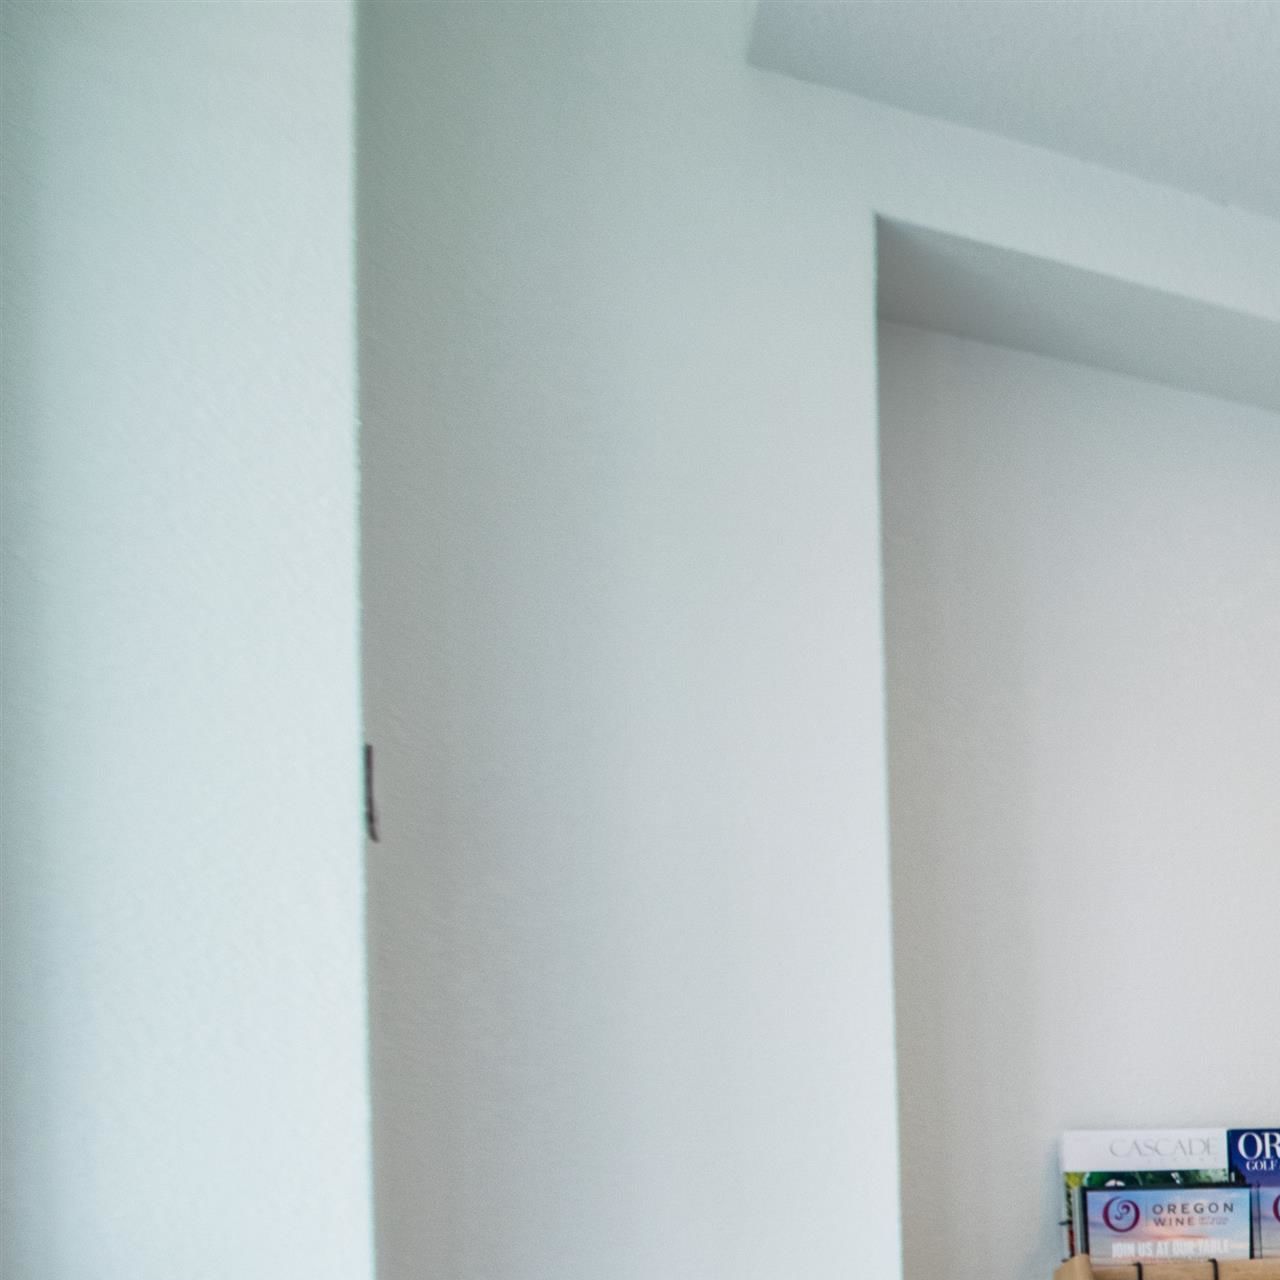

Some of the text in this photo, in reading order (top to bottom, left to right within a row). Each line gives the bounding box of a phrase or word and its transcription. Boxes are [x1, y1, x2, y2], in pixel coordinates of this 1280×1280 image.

[1246, 1159, 1275, 1171] GOLF
[1152, 1203, 1234, 1214] OREGON
[1153, 1217, 1196, 1226] WINE
